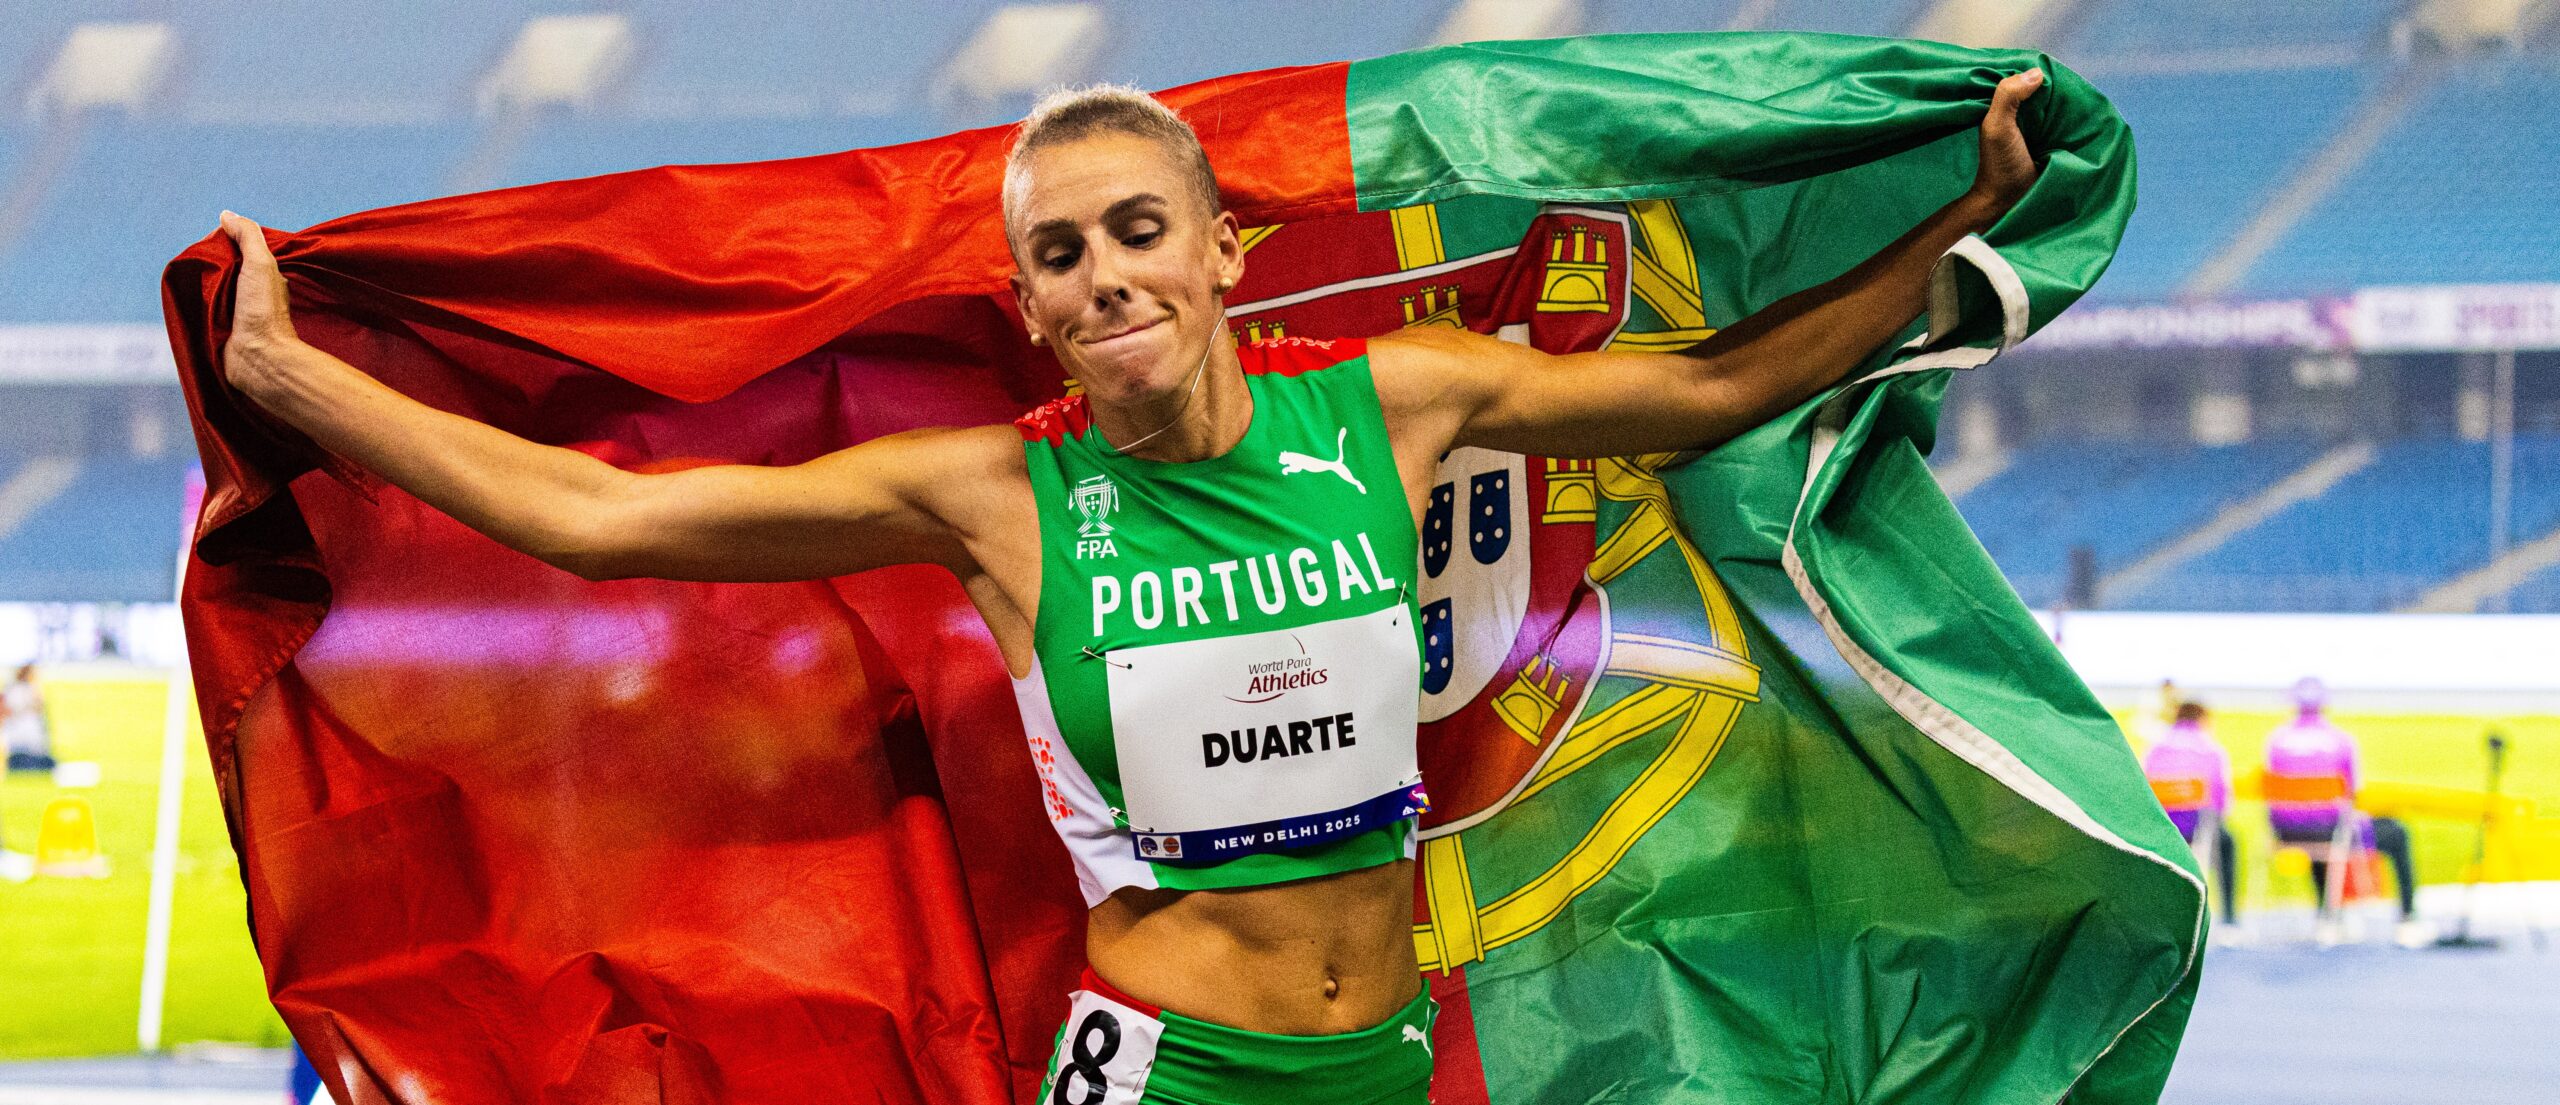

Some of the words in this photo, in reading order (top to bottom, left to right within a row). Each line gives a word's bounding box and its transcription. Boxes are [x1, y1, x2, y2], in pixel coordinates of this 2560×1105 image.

[1076, 538, 1119, 560] FPA
[1092, 532, 1396, 637] PORTUGAL
[1247, 668, 1328, 695] Athletics
[1248, 661, 1283, 675] World
[1286, 657, 1312, 670] Para
[1201, 712, 1357, 768] DUARTE
[1214, 834, 1255, 850] NEW
[1263, 824, 1319, 843] DELHI
[1325, 815, 1361, 833] 2025
[1053, 1010, 1121, 1105] 8
